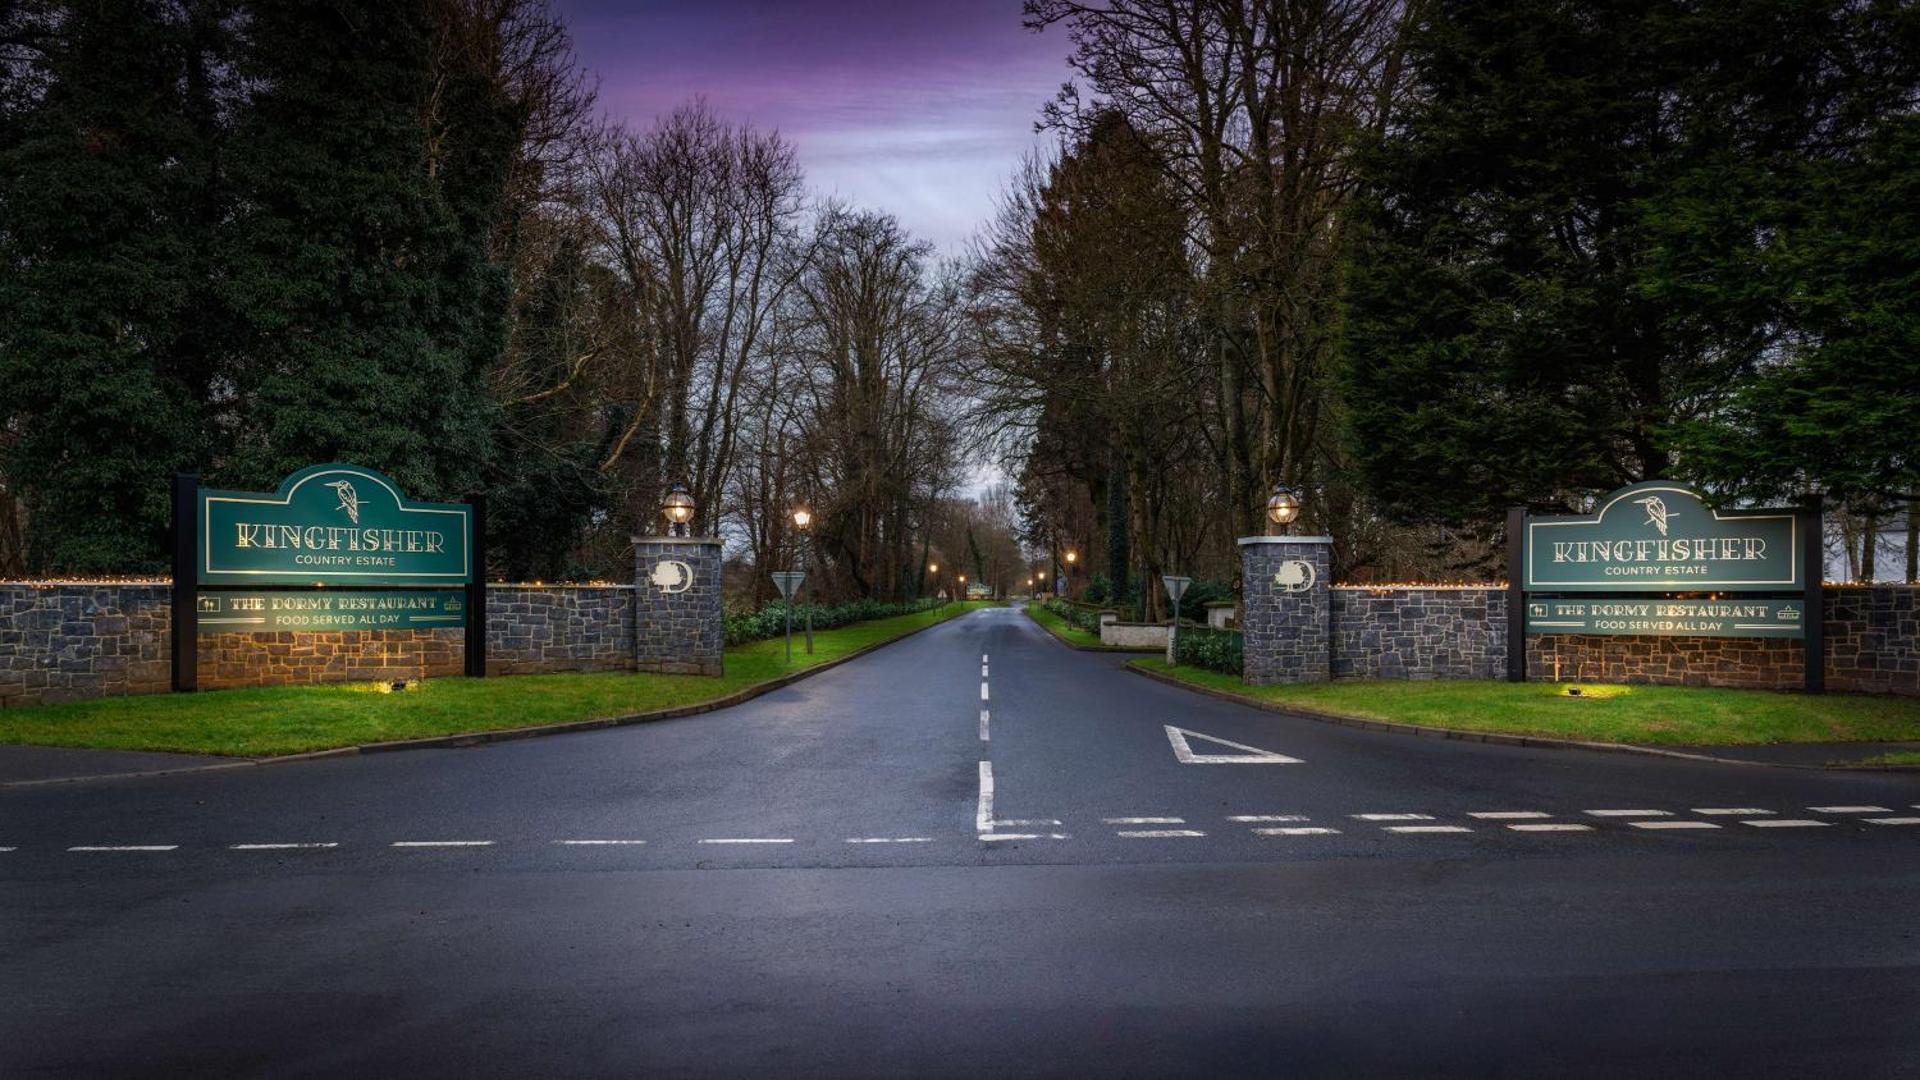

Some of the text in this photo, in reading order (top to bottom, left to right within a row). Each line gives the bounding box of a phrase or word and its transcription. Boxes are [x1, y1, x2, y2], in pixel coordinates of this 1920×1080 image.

[235, 522, 445, 553] KINGFISHER
[1552, 537, 1768, 563] KINGFISHER
[295, 555, 396, 567] COUNTRY ESTATE
[1604, 565, 1708, 576] COUNTRY ESTATE
[230, 597, 437, 610] THE DORMY RESTAURANT
[1554, 604, 1769, 618] THE DORMY RESTAURANT
[276, 615, 400, 625] FOOD SERVED ALL DAY
[1595, 620, 1723, 631] FOOD SERVED ALL DAY
